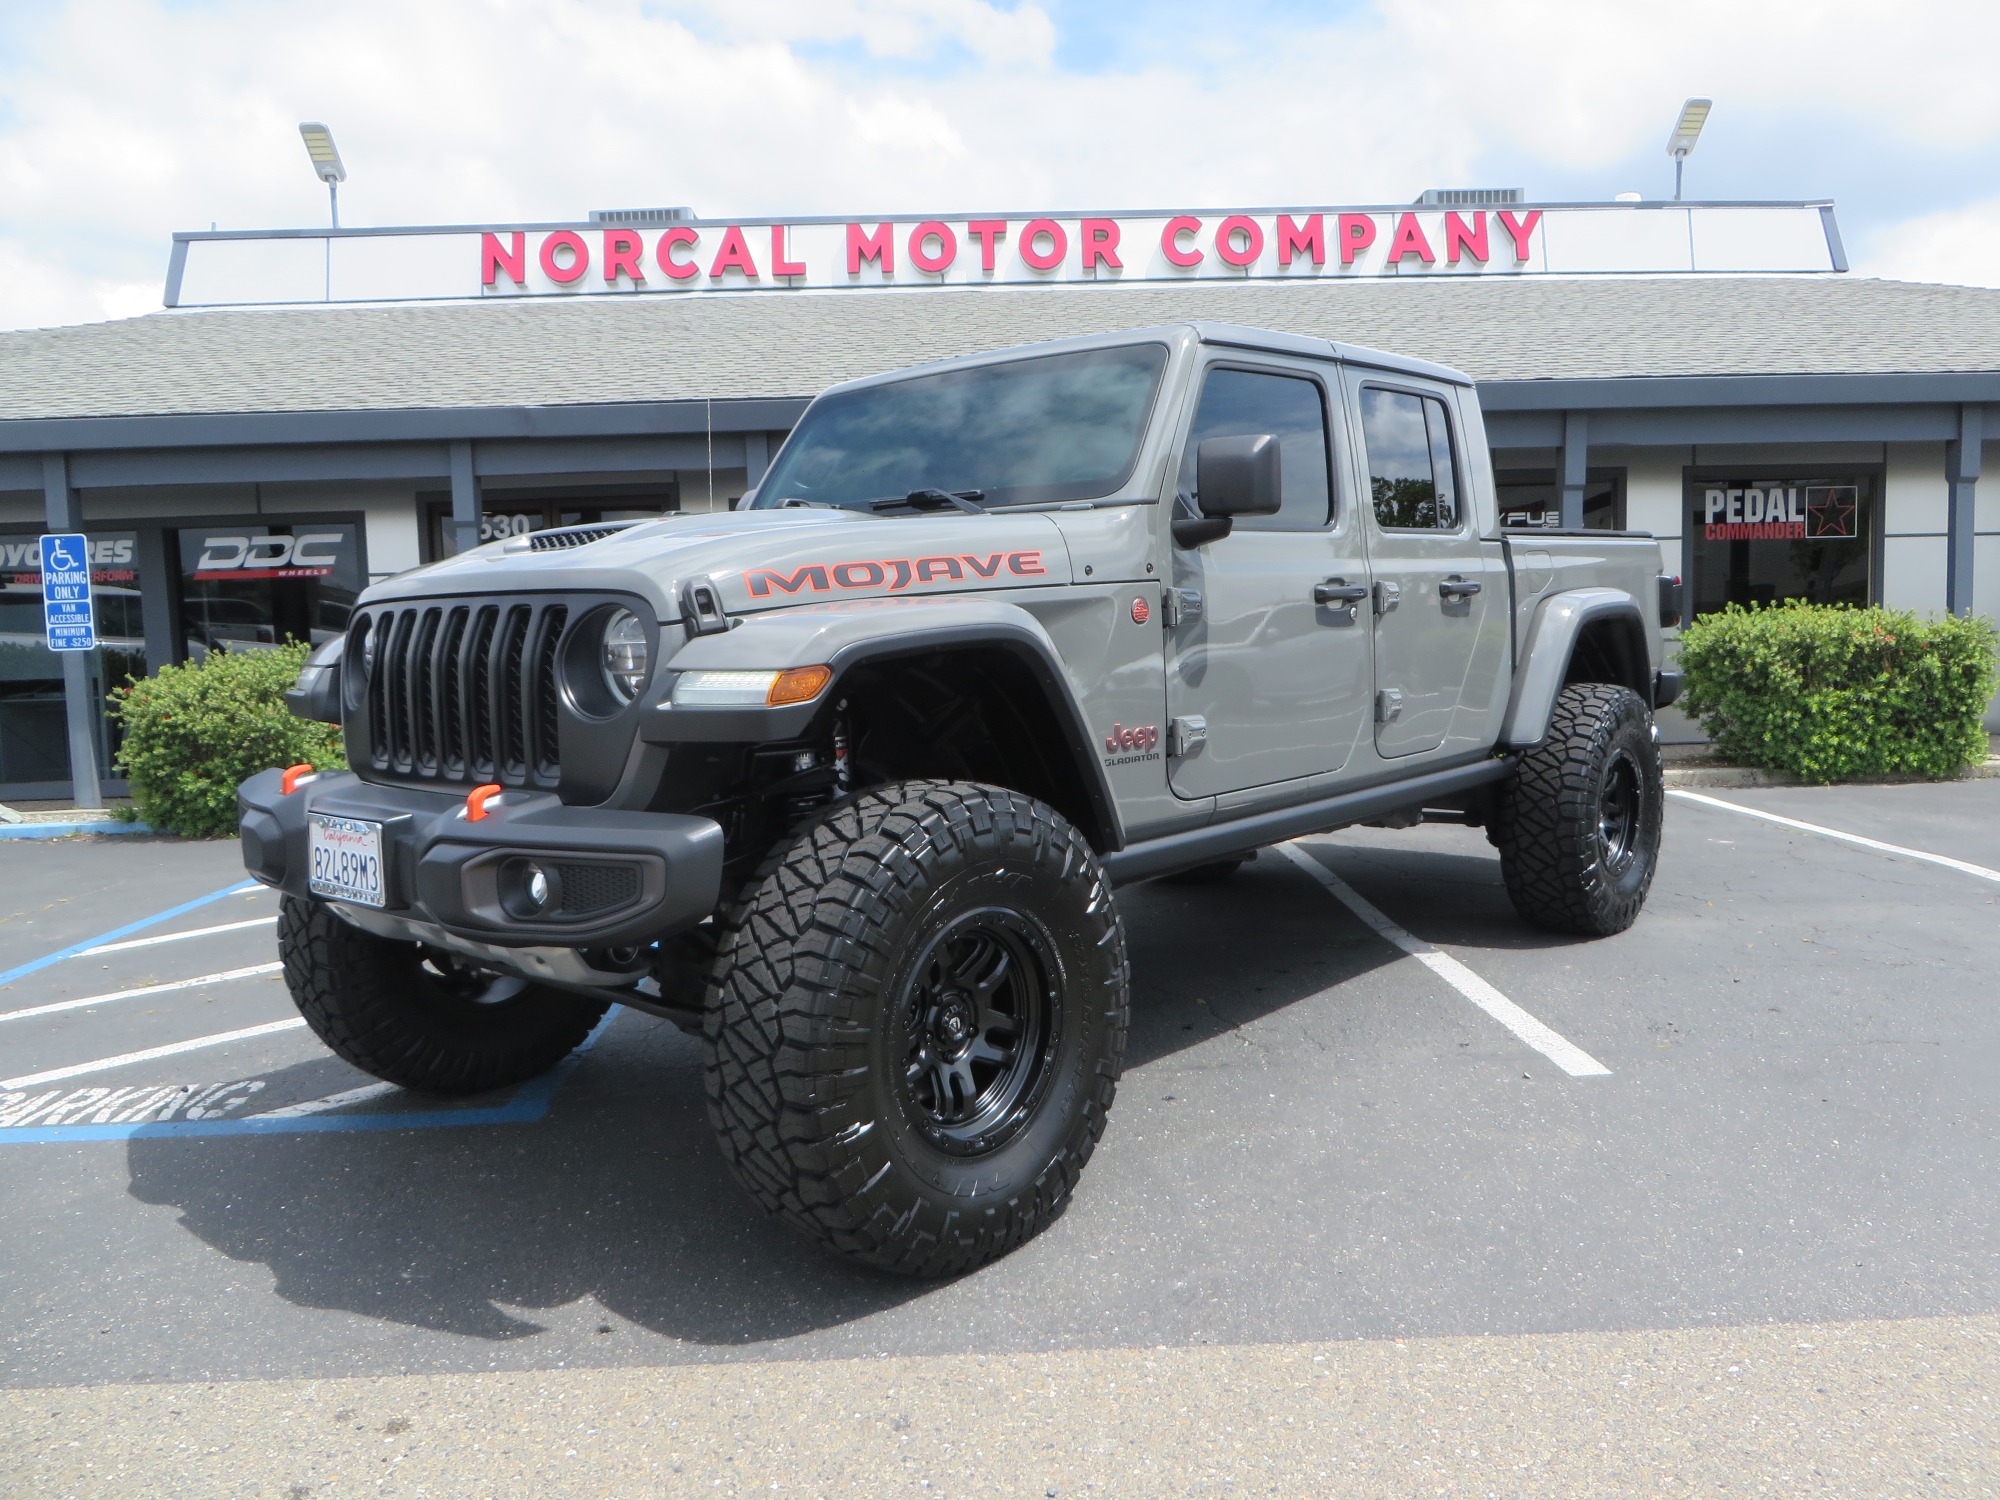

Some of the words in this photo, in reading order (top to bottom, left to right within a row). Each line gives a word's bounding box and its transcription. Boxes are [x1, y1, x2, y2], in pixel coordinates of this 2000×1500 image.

[482, 225, 806, 288] NORCAL
[847, 218, 1123, 276] MOTOR
[1161, 210, 1543, 271] COMPANY
[1705, 488, 1804, 523] PEDAL
[1507, 511, 1560, 525] FUE
[1705, 523, 1804, 540] COMMANDER
[197, 533, 343, 570] DDC
[46, 571, 86, 585] PARKING
[278, 569, 328, 577] WHEELS
[743, 551, 1046, 598] MOJAVE
[54, 586, 80, 600] ONLY
[61, 603, 76, 612] VAN
[50, 613, 89, 624] ACCESSIBLE
[55, 627, 86, 636] MINIMUM
[51, 638, 66, 647] FINE
[1106, 723, 1159, 754] Jeep
[1104, 752, 1160, 767] GLADIATOR
[314, 846, 379, 891] 82489M3
